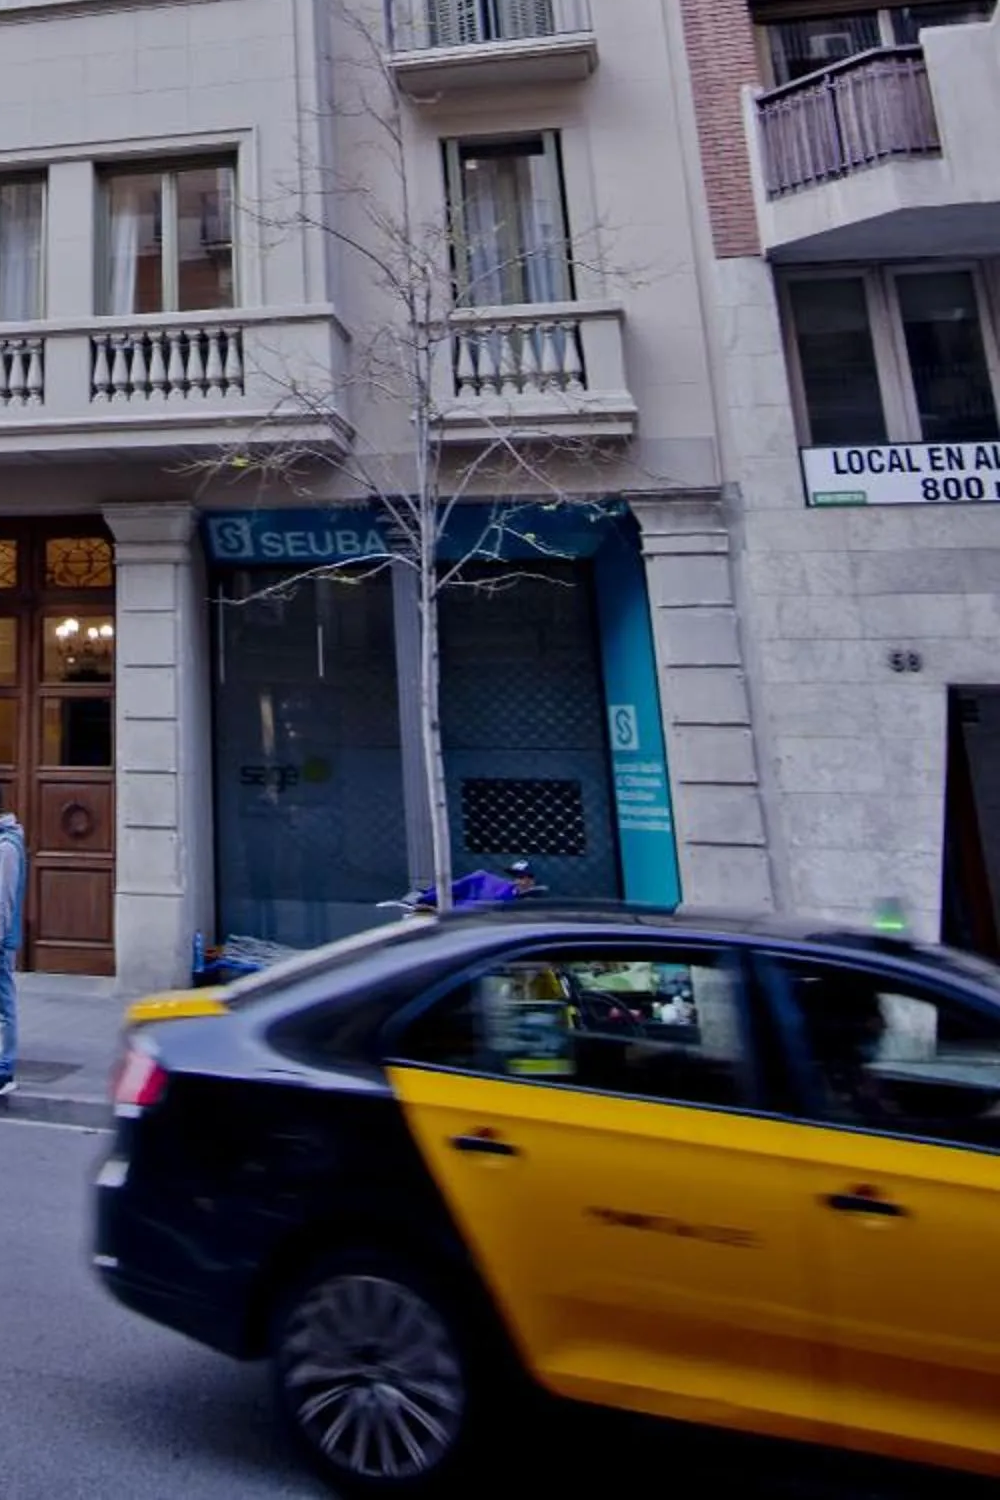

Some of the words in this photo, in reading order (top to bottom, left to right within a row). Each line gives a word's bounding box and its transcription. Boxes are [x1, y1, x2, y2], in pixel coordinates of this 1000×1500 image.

[833, 449, 922, 475] LOCAL
[927, 446, 965, 472] EN
[921, 476, 984, 501] 800
